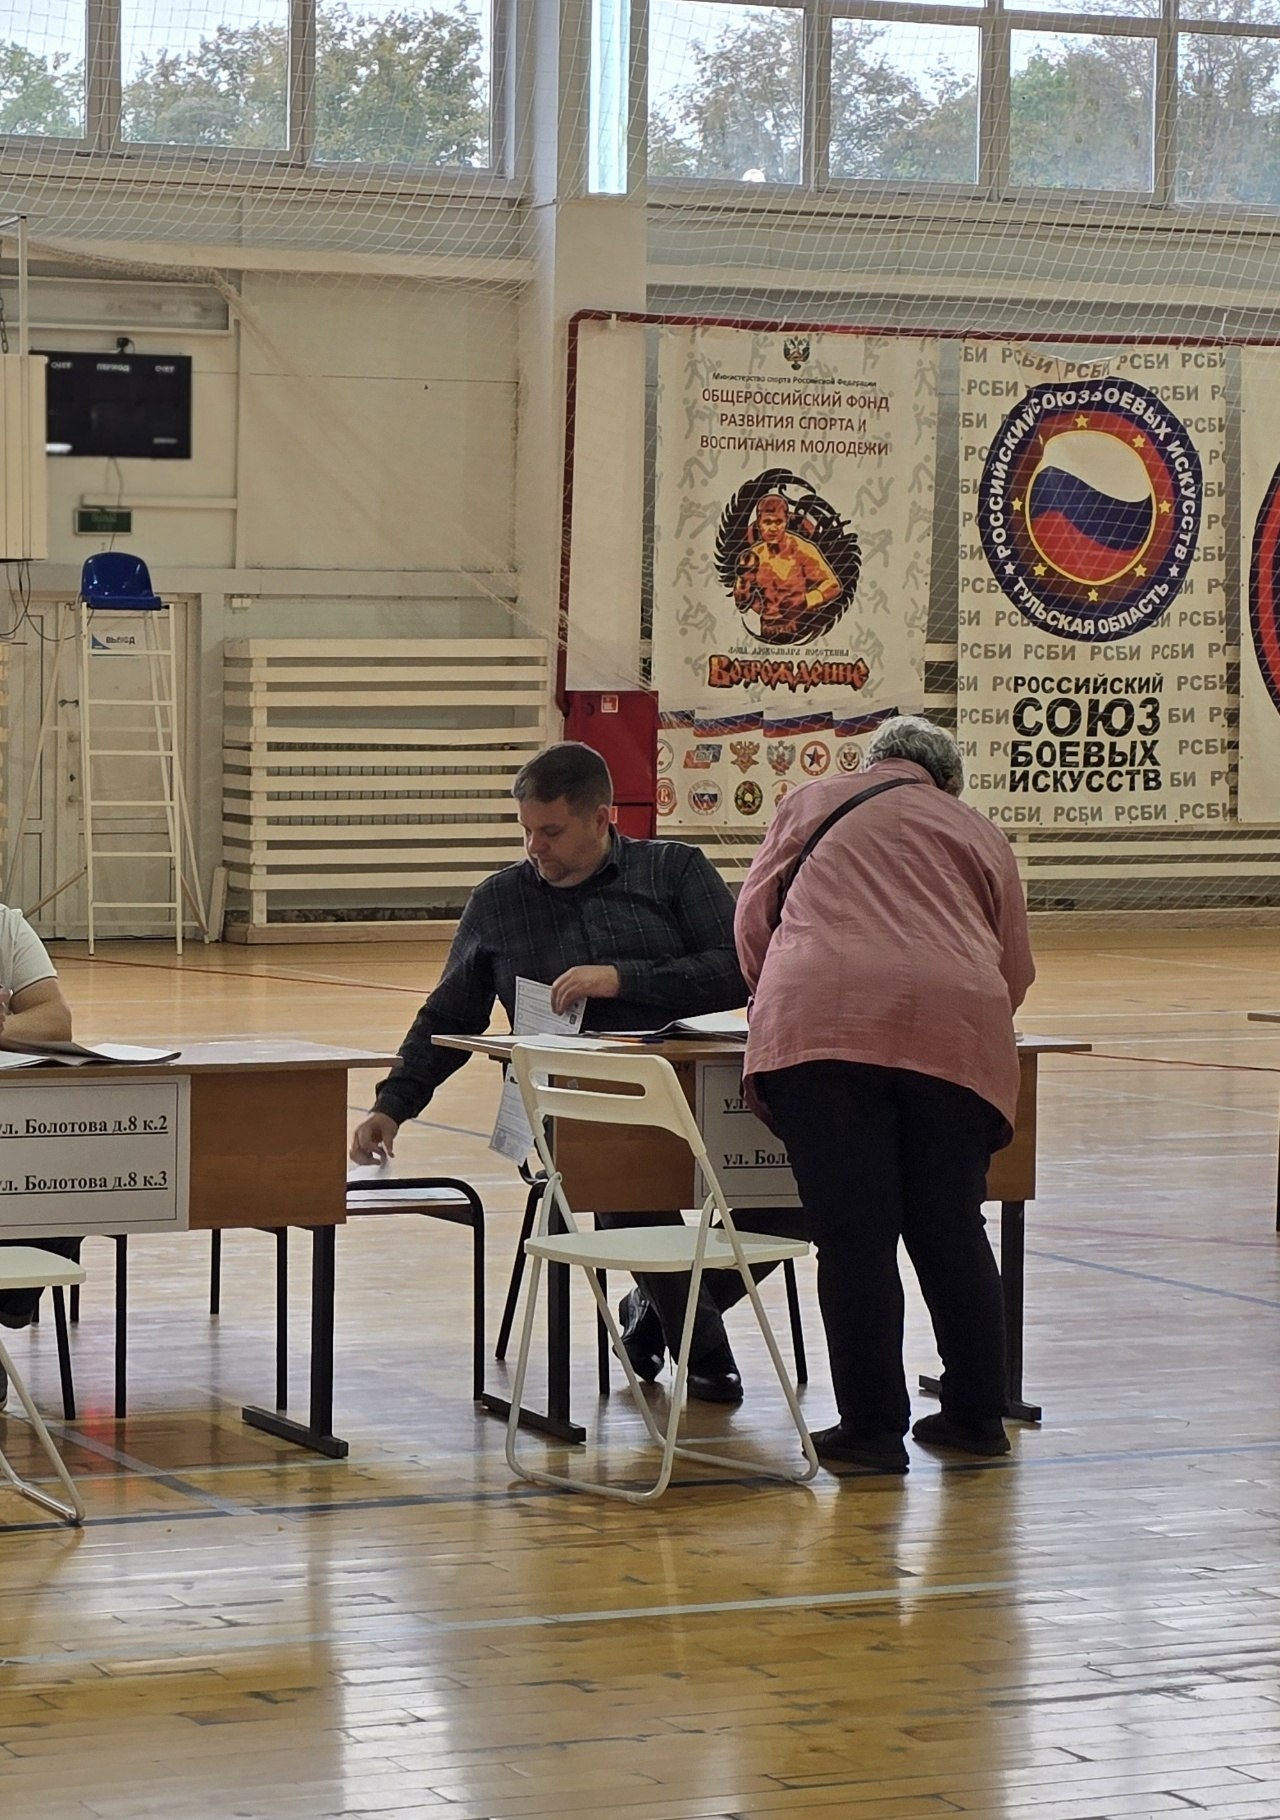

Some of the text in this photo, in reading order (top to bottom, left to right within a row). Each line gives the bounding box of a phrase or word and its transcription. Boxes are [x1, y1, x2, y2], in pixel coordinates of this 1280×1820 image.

[967, 380, 1018, 397] РСБИ
[702, 387, 890, 412] ОБЩЕРОССИЙСКИЙ ФОНД
[720, 413, 867, 432] РАЗВИТИЯ СПОРТА И
[700, 435, 889, 457] ВОСПИТАНИЯ МОЛОДЕЖИ
[989, 406, 1038, 559] РОССИЙСКИЙ
[1030, 389, 1090, 414] СОЮЗ
[1166, 440, 1197, 560] ИСКУССТВ
[1013, 577, 1169, 635] ТУЛЬСКАЯ ОБЛАСТЬ
[961, 643, 1011, 659] РСБИ
[1023, 644, 1076, 660] РСБИ
[1090, 645, 1141, 661] РСБИ
[1151, 643, 1194, 660] РСБИ
[1013, 673, 1163, 694] РОССИЙСКИЙ
[960, 708, 1010, 725] РСБИ
[1012, 697, 1161, 737] СОЮЗ
[1010, 740, 1161, 768] БОЕВЫХ
[1009, 769, 1162, 793] ИСКУССТВ
[988, 806, 1041, 822] РСБИ
[1054, 806, 1102, 822] РСБИ
[1115, 804, 1166, 821] РСБИ
[724, 1098, 748, 1110] ул.
[25, 1118, 108, 1135] Болотова
[112, 1115, 138, 1134] д.8
[143, 1115, 168, 1131] к.2
[724, 1153, 748, 1166] ул.
[24, 1174, 108, 1191] Болотова
[112, 1172, 138, 1190] д.8
[143, 1171, 168, 1187] к.3
